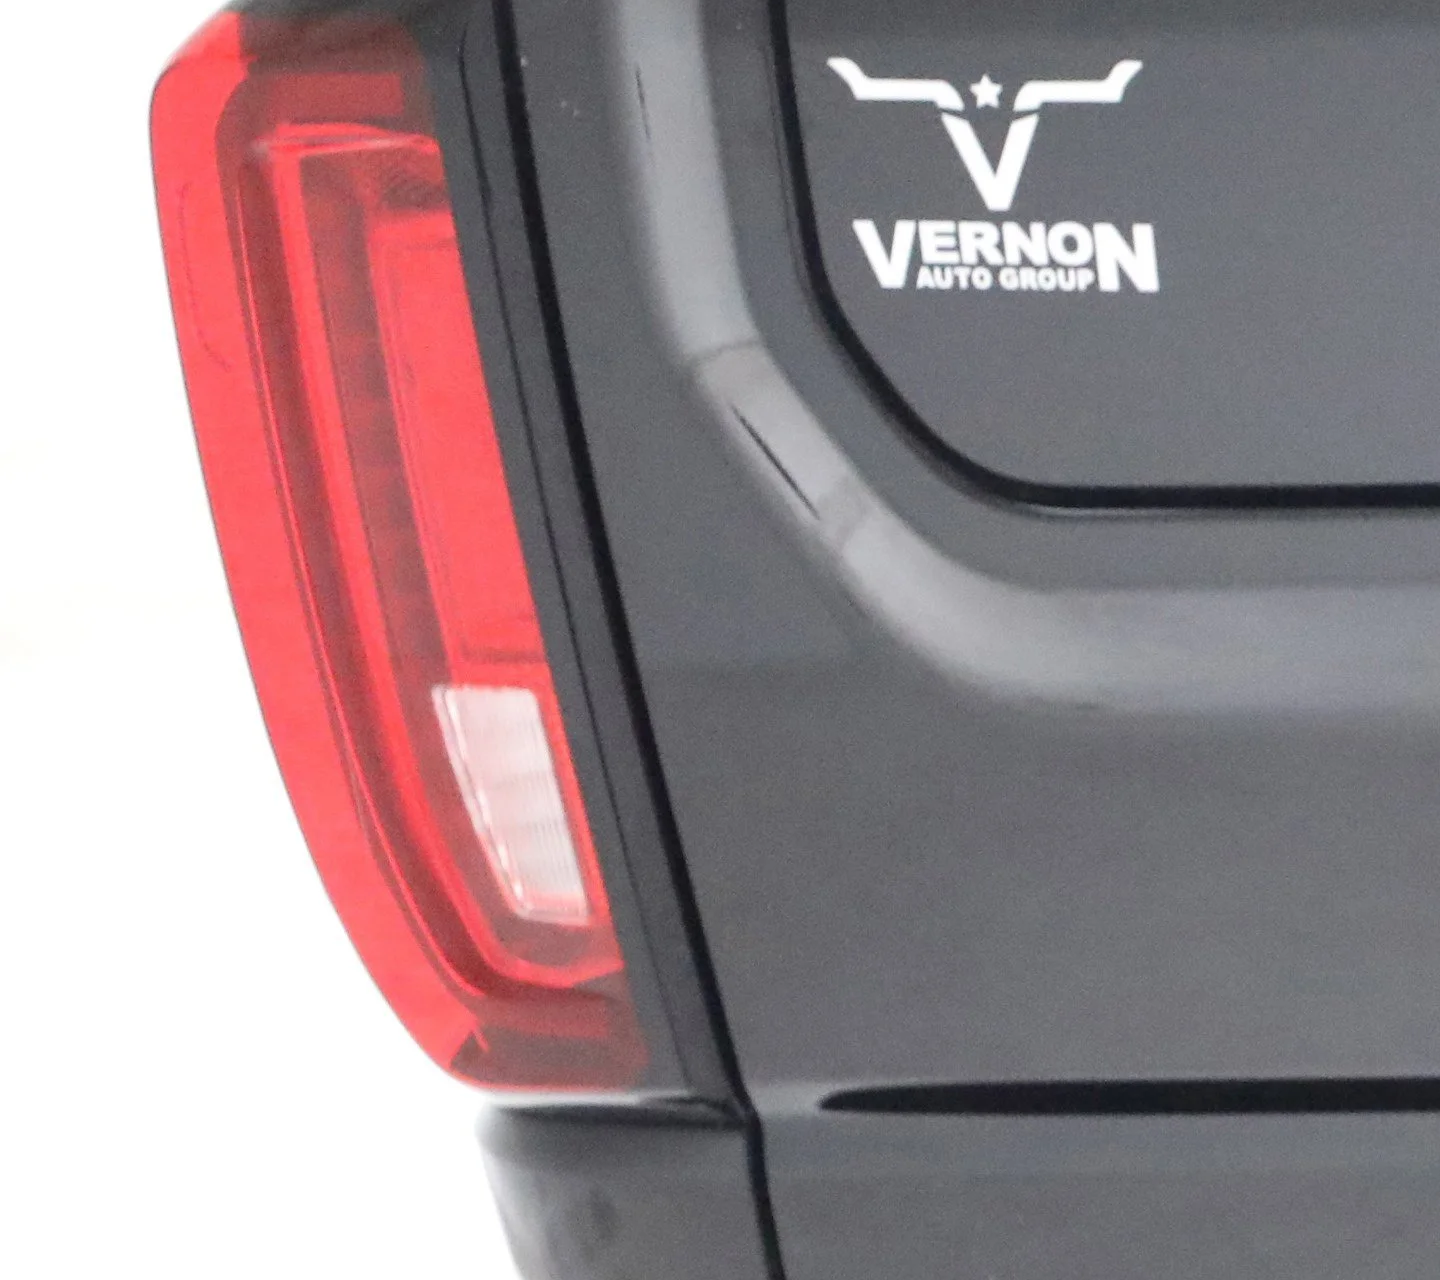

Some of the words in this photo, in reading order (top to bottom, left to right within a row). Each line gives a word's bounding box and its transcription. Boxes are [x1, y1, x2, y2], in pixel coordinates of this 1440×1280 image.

[853, 218, 1160, 293] VERNON
[916, 266, 993, 291] AUTO
[997, 266, 1096, 292] GROUP
